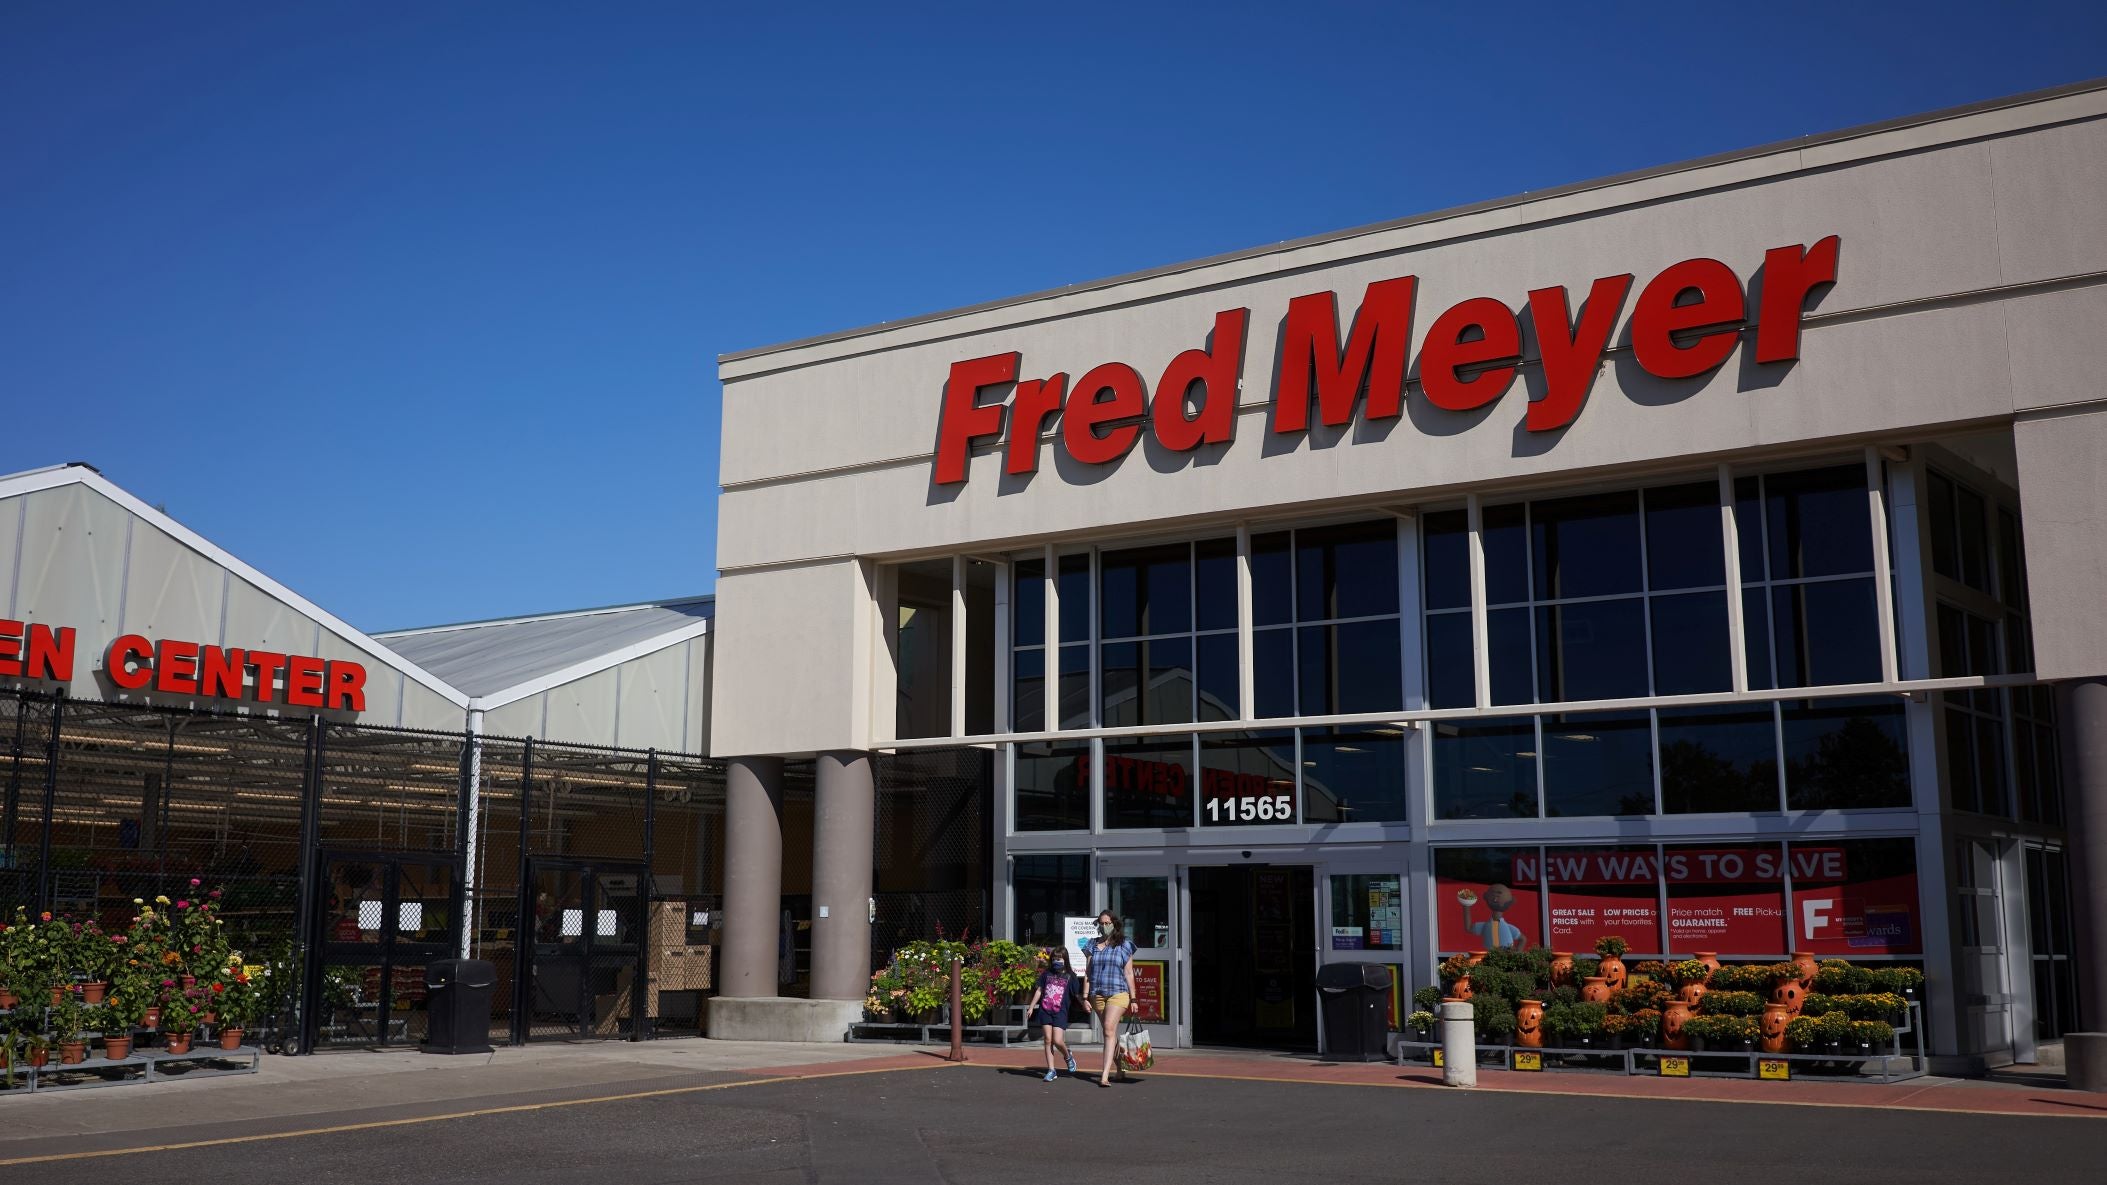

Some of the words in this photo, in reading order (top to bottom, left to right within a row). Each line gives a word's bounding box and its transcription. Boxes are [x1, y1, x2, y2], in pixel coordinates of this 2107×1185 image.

[935, 306, 1251, 485] Fred
[1273, 235, 1840, 433] Meyer
[103, 633, 366, 712] CENTER
[1206, 795, 1292, 822] 11565
[1516, 857, 1588, 881] NEW
[1698, 853, 1744, 879] TO
[1755, 852, 1842, 879] SAVE
[1671, 908, 1692, 917] Price
[1694, 908, 1723, 917] match
[1733, 907, 1754, 916] FREE
[1802, 898, 1833, 940] F
